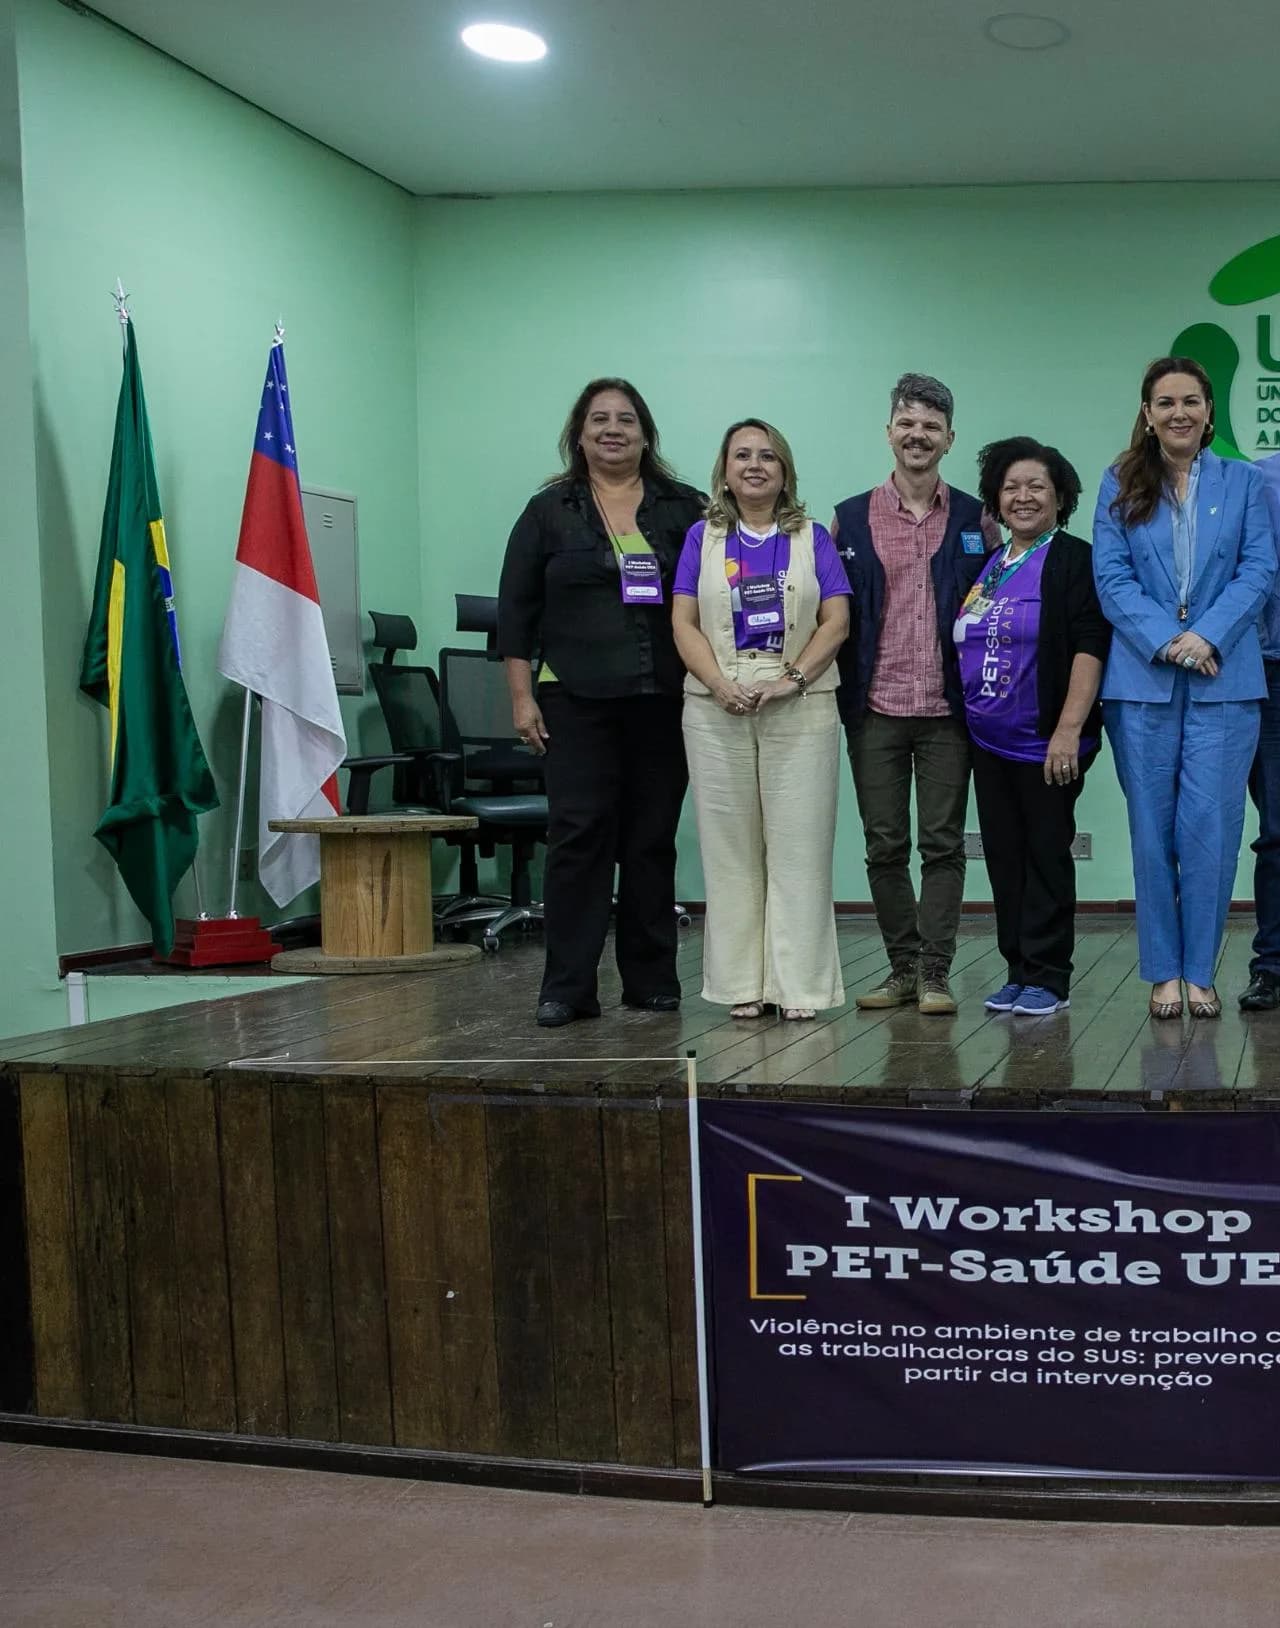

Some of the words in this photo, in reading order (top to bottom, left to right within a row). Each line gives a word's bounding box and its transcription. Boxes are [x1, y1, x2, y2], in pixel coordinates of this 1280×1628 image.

[845, 1196, 870, 1227] I
[889, 1196, 1252, 1242] Workshop
[786, 1244, 1162, 1286] PET-Saúde
[750, 1318, 882, 1336] Violência
[892, 1323, 926, 1337] no
[935, 1324, 1076, 1341] ambiente
[1084, 1327, 1121, 1342] de
[1129, 1327, 1257, 1344] trabalho
[779, 1342, 812, 1356] as
[821, 1341, 1029, 1362] trabalhadoras
[1038, 1346, 1075, 1363] do
[1084, 1349, 1145, 1364] SUS:
[905, 1366, 982, 1384] partir
[990, 1368, 1027, 1383] da
[1037, 1368, 1213, 1390] intervenção
